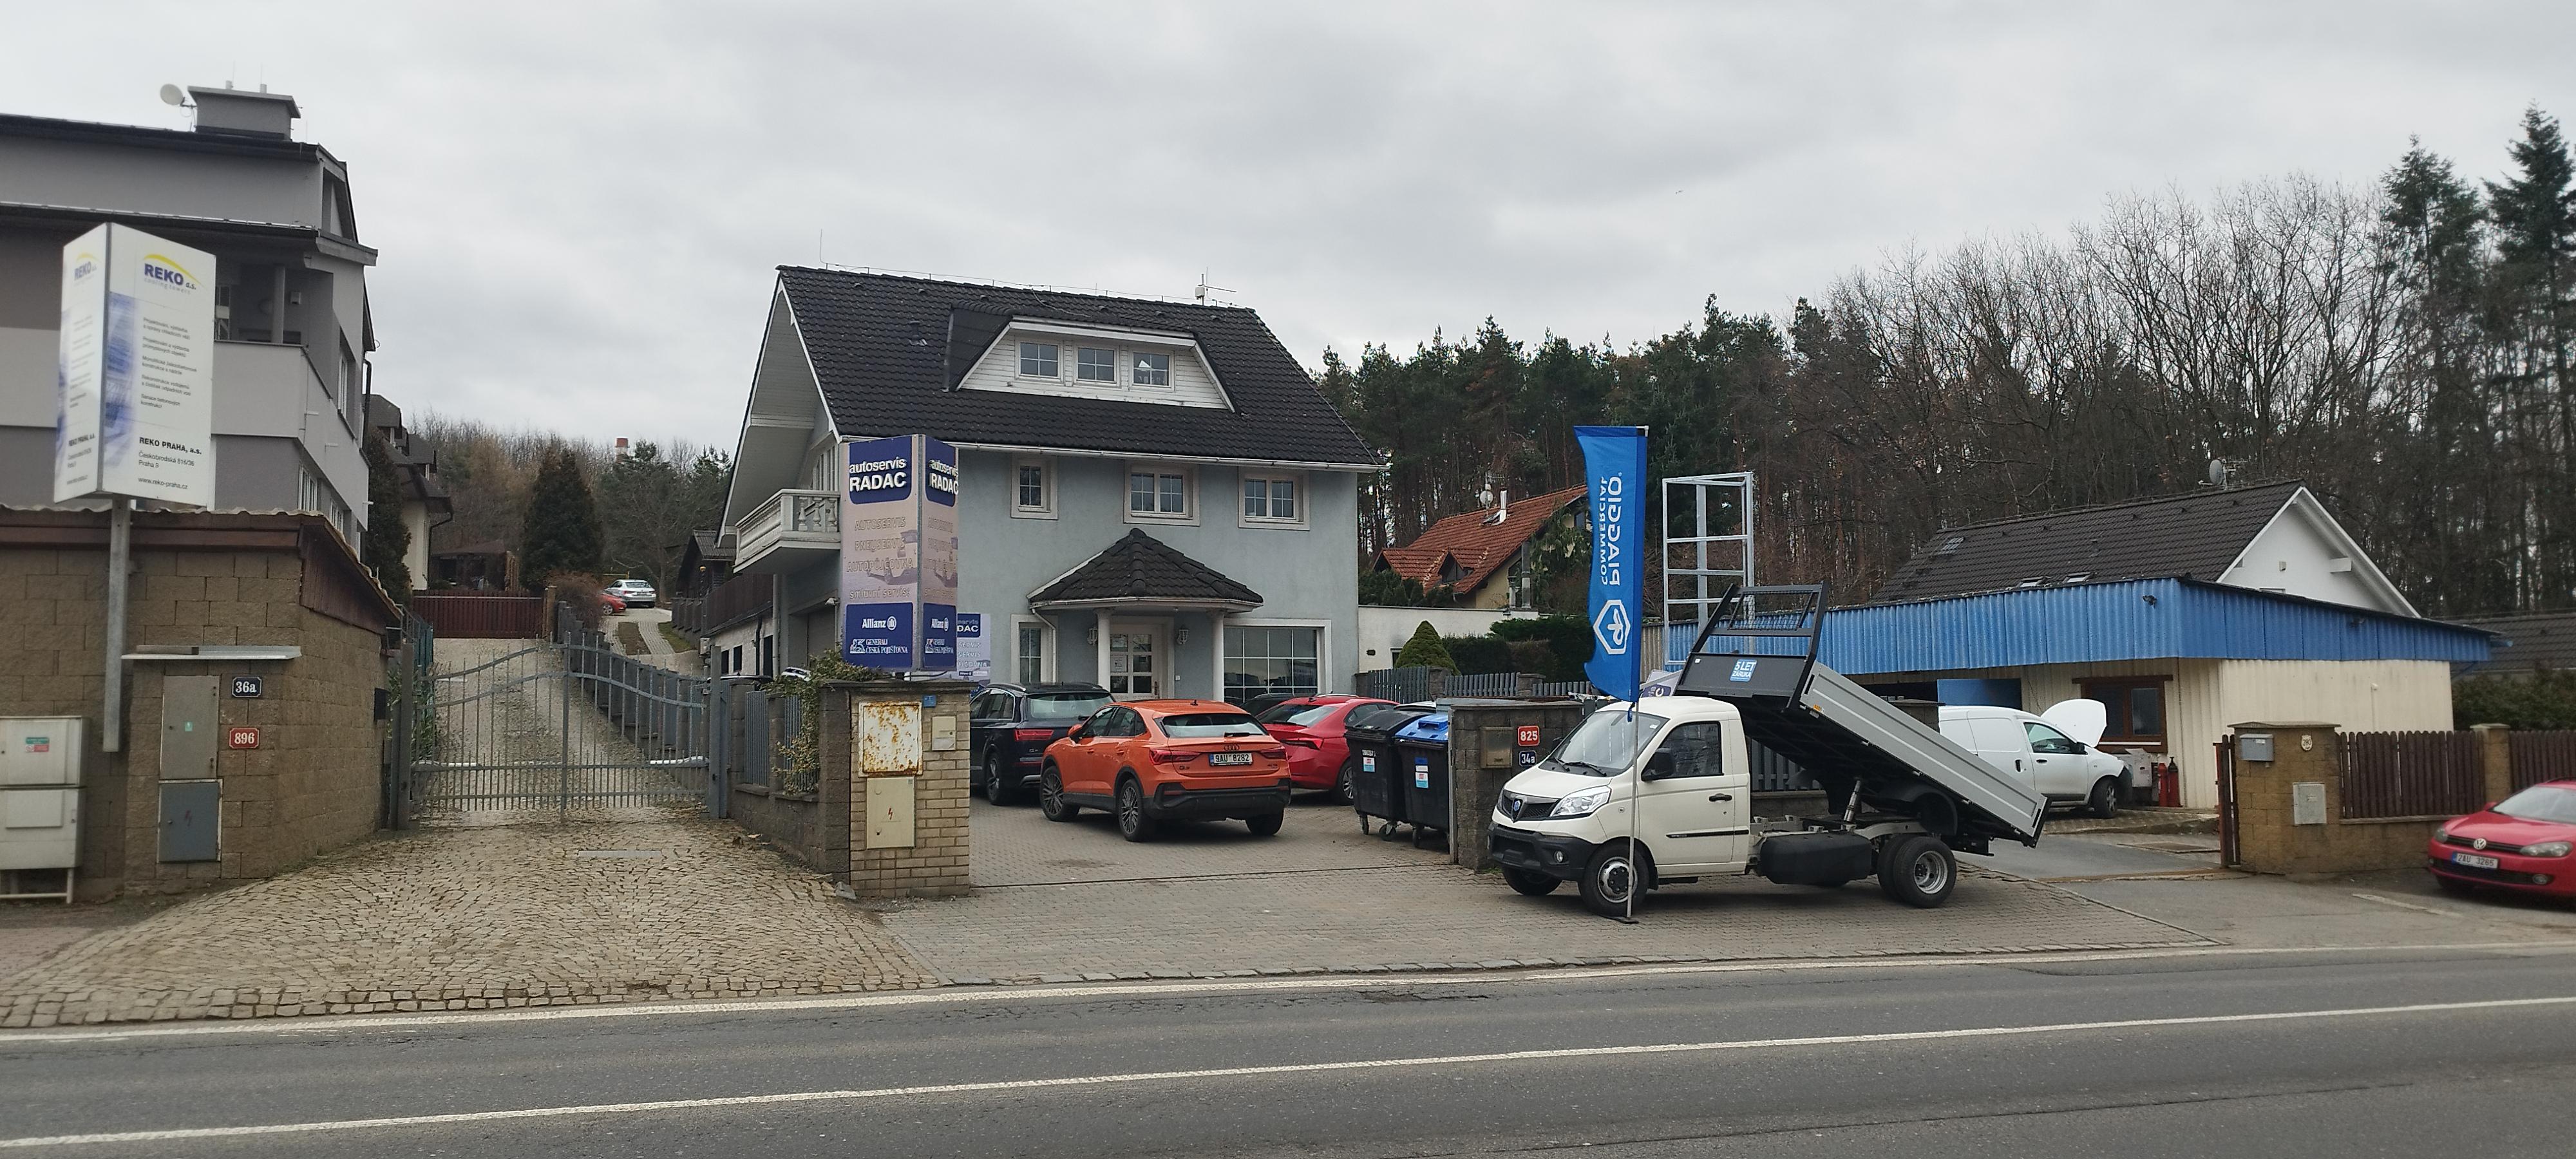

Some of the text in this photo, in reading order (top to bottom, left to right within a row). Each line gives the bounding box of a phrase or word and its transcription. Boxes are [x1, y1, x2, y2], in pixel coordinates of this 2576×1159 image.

[144, 263, 184, 285] REKO
[139, 437, 160, 447] REKO
[162, 441, 188, 453] PRAHA,
[138, 450, 176, 464] Českobrodská
[138, 459, 155, 468] Praha
[849, 457, 907, 474] autoservis
[138, 478, 188, 489] www.reko-praha.cz
[849, 471, 907, 492] RADAC
[929, 473, 959, 495] RADAC
[855, 517, 907, 531] AUTOSERVIS
[855, 538, 907, 552] PNEUSERVIS
[849, 587, 881, 599] smluvní
[862, 619, 887, 629] Allianz
[1740, 661, 1757, 672] LET
[235, 681, 257, 693] 36a
[234, 732, 255, 744] 896
[1520, 730, 1538, 742] 825
[1233, 754, 1249, 762] 8282
[1521, 753, 1535, 764] 34a
